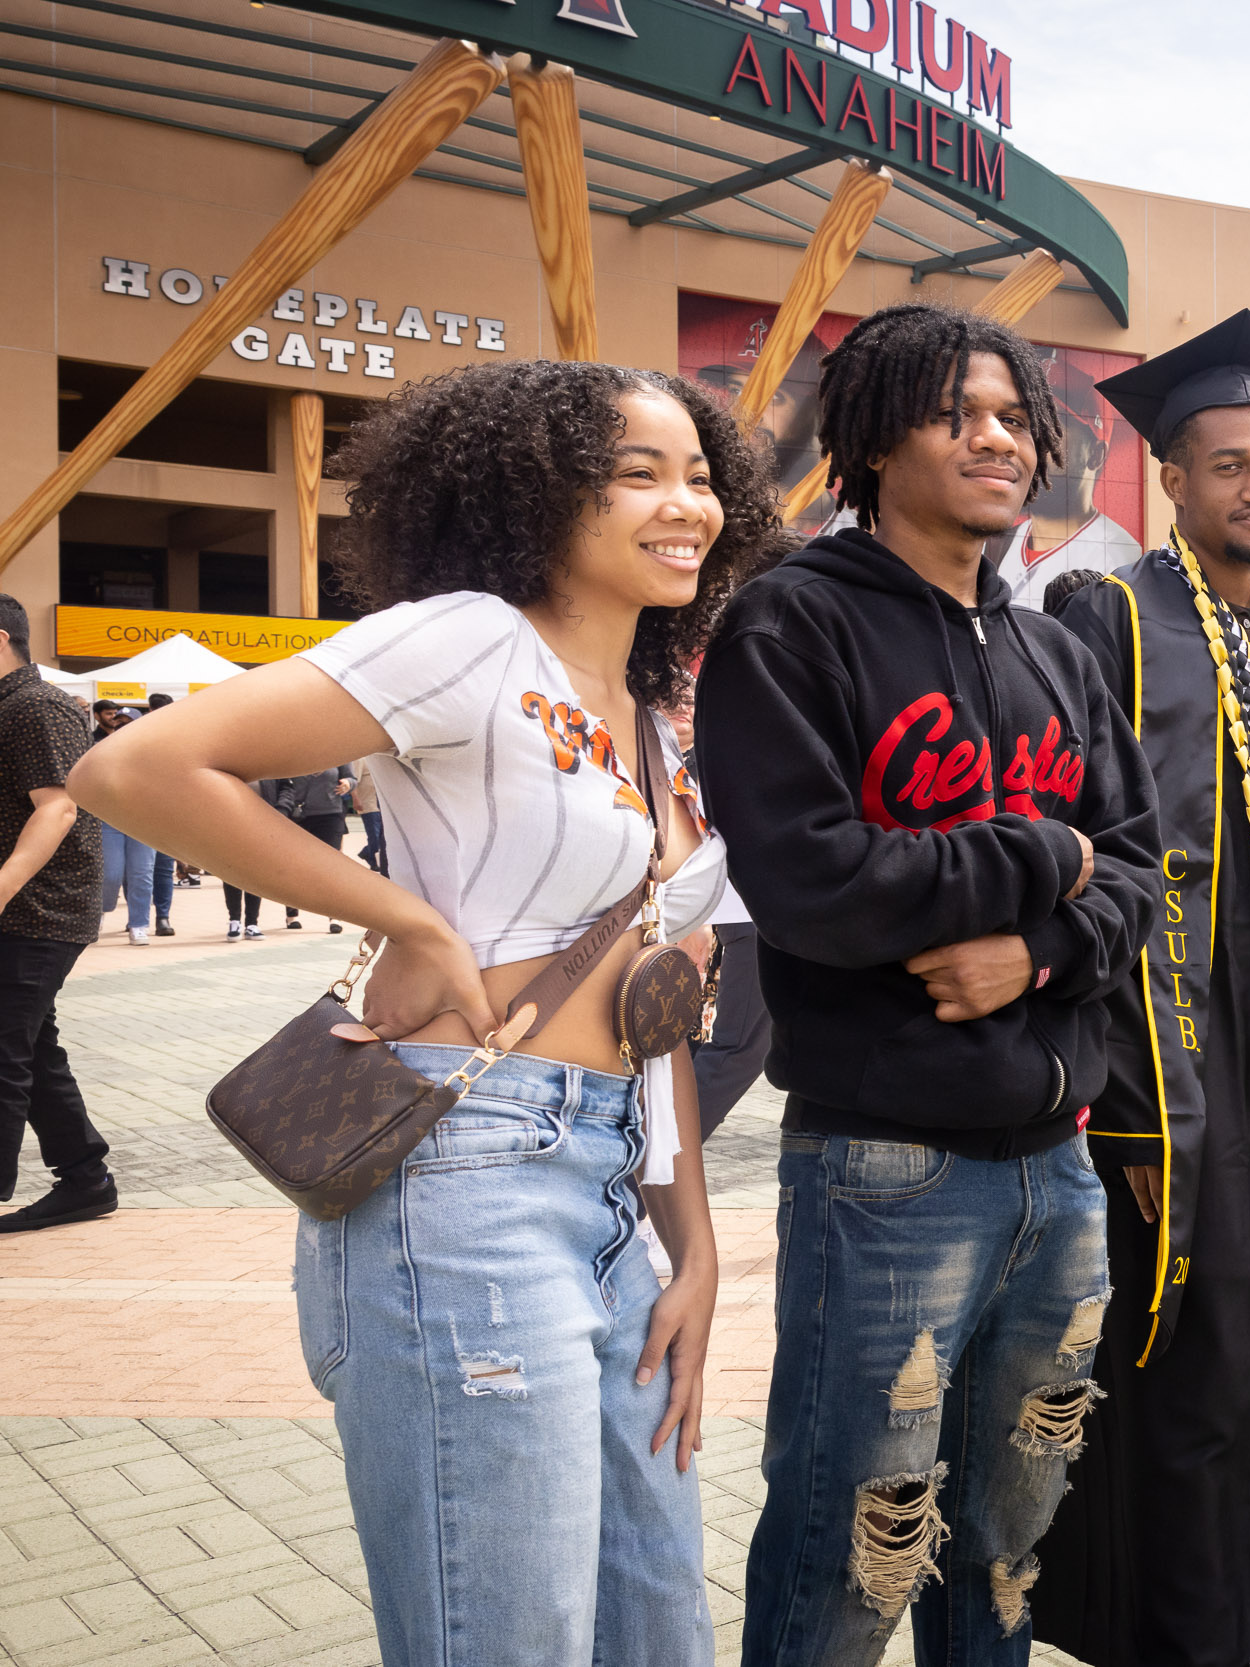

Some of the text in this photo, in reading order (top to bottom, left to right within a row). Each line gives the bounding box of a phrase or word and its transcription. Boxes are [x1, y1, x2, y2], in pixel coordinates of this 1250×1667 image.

[723, 32, 1006, 201] ANAHEIM
[102, 256, 506, 352] HOEPLATE
[229, 325, 396, 379] GATE
[106, 624, 331, 650] CONGATULATION
[562, 917, 620, 981] VUITTON
